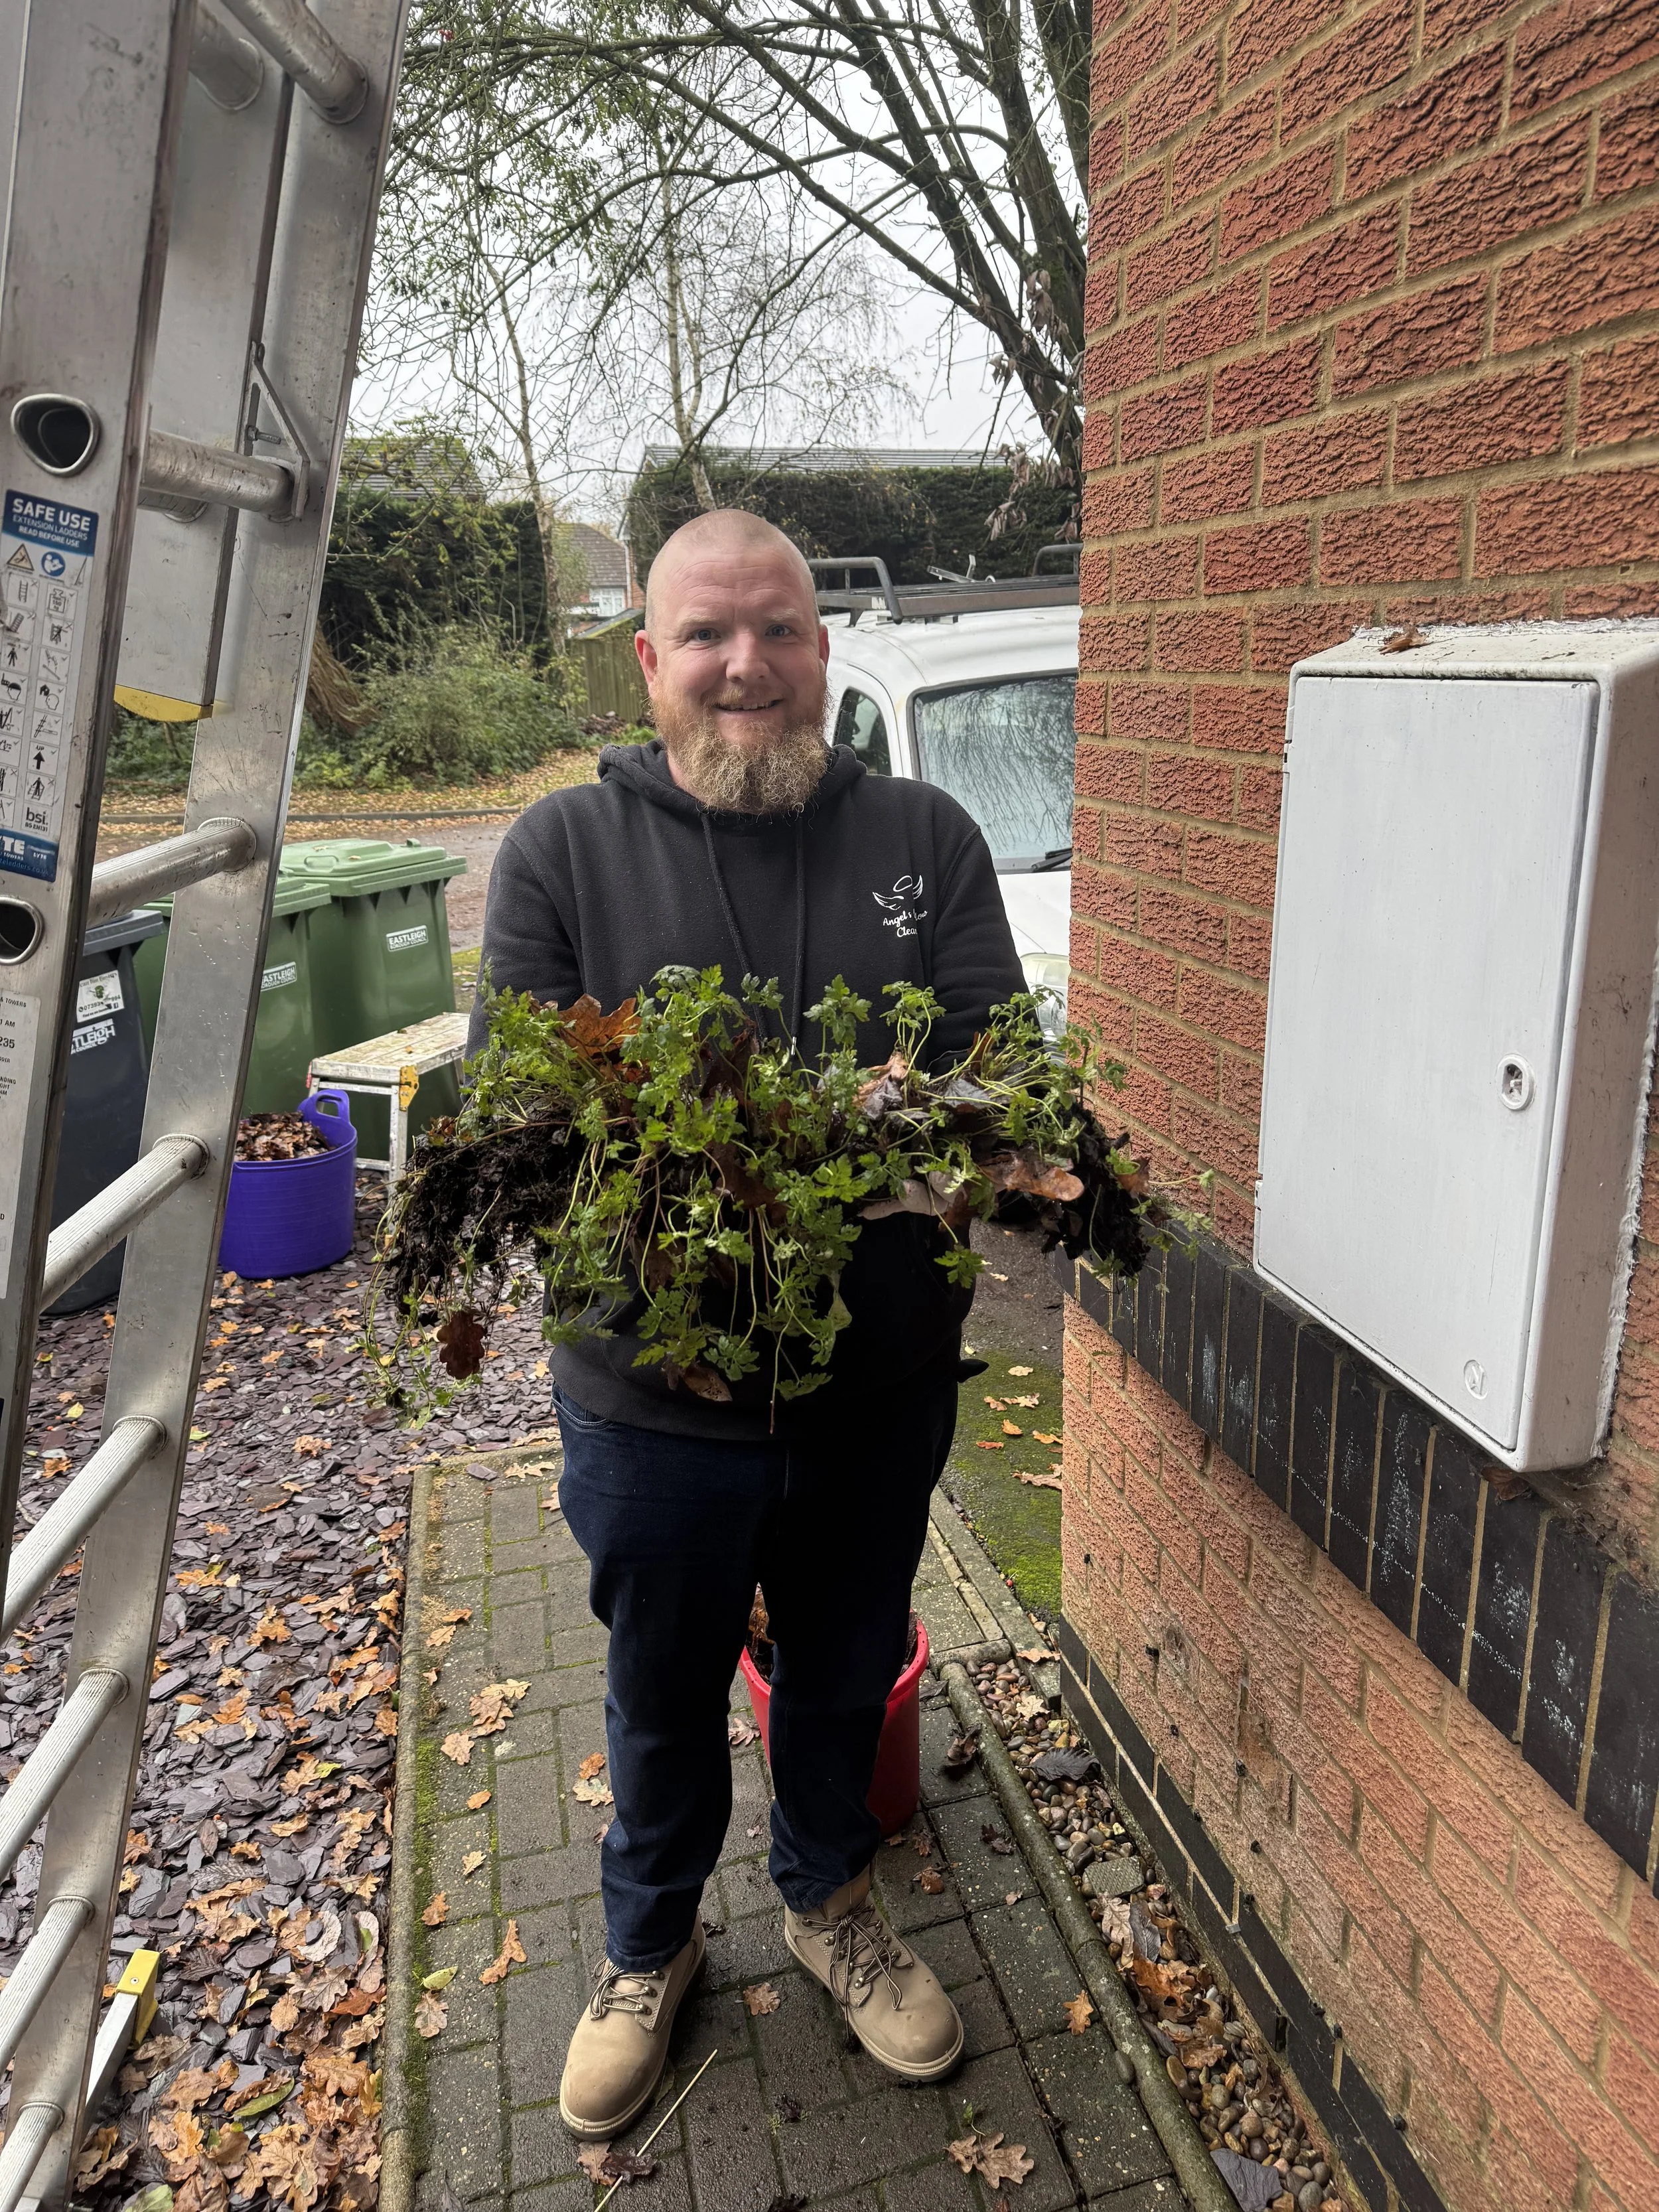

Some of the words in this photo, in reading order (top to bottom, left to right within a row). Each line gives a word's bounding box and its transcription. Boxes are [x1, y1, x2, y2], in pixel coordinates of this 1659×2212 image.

[12, 498, 56, 522] SAFE
[58, 510, 91, 532] USE
[13, 514, 54, 532] EXTENSION
[54, 525, 88, 541] LADDERS
[19, 525, 38, 537] READ
[38, 531, 65, 544] BEFORE
[33, 823, 48, 832] EN131
[0, 835, 25, 855] TE
[389, 929, 426, 945] EASTLEIGH
[263, 966, 295, 984] ASTLEIGH
